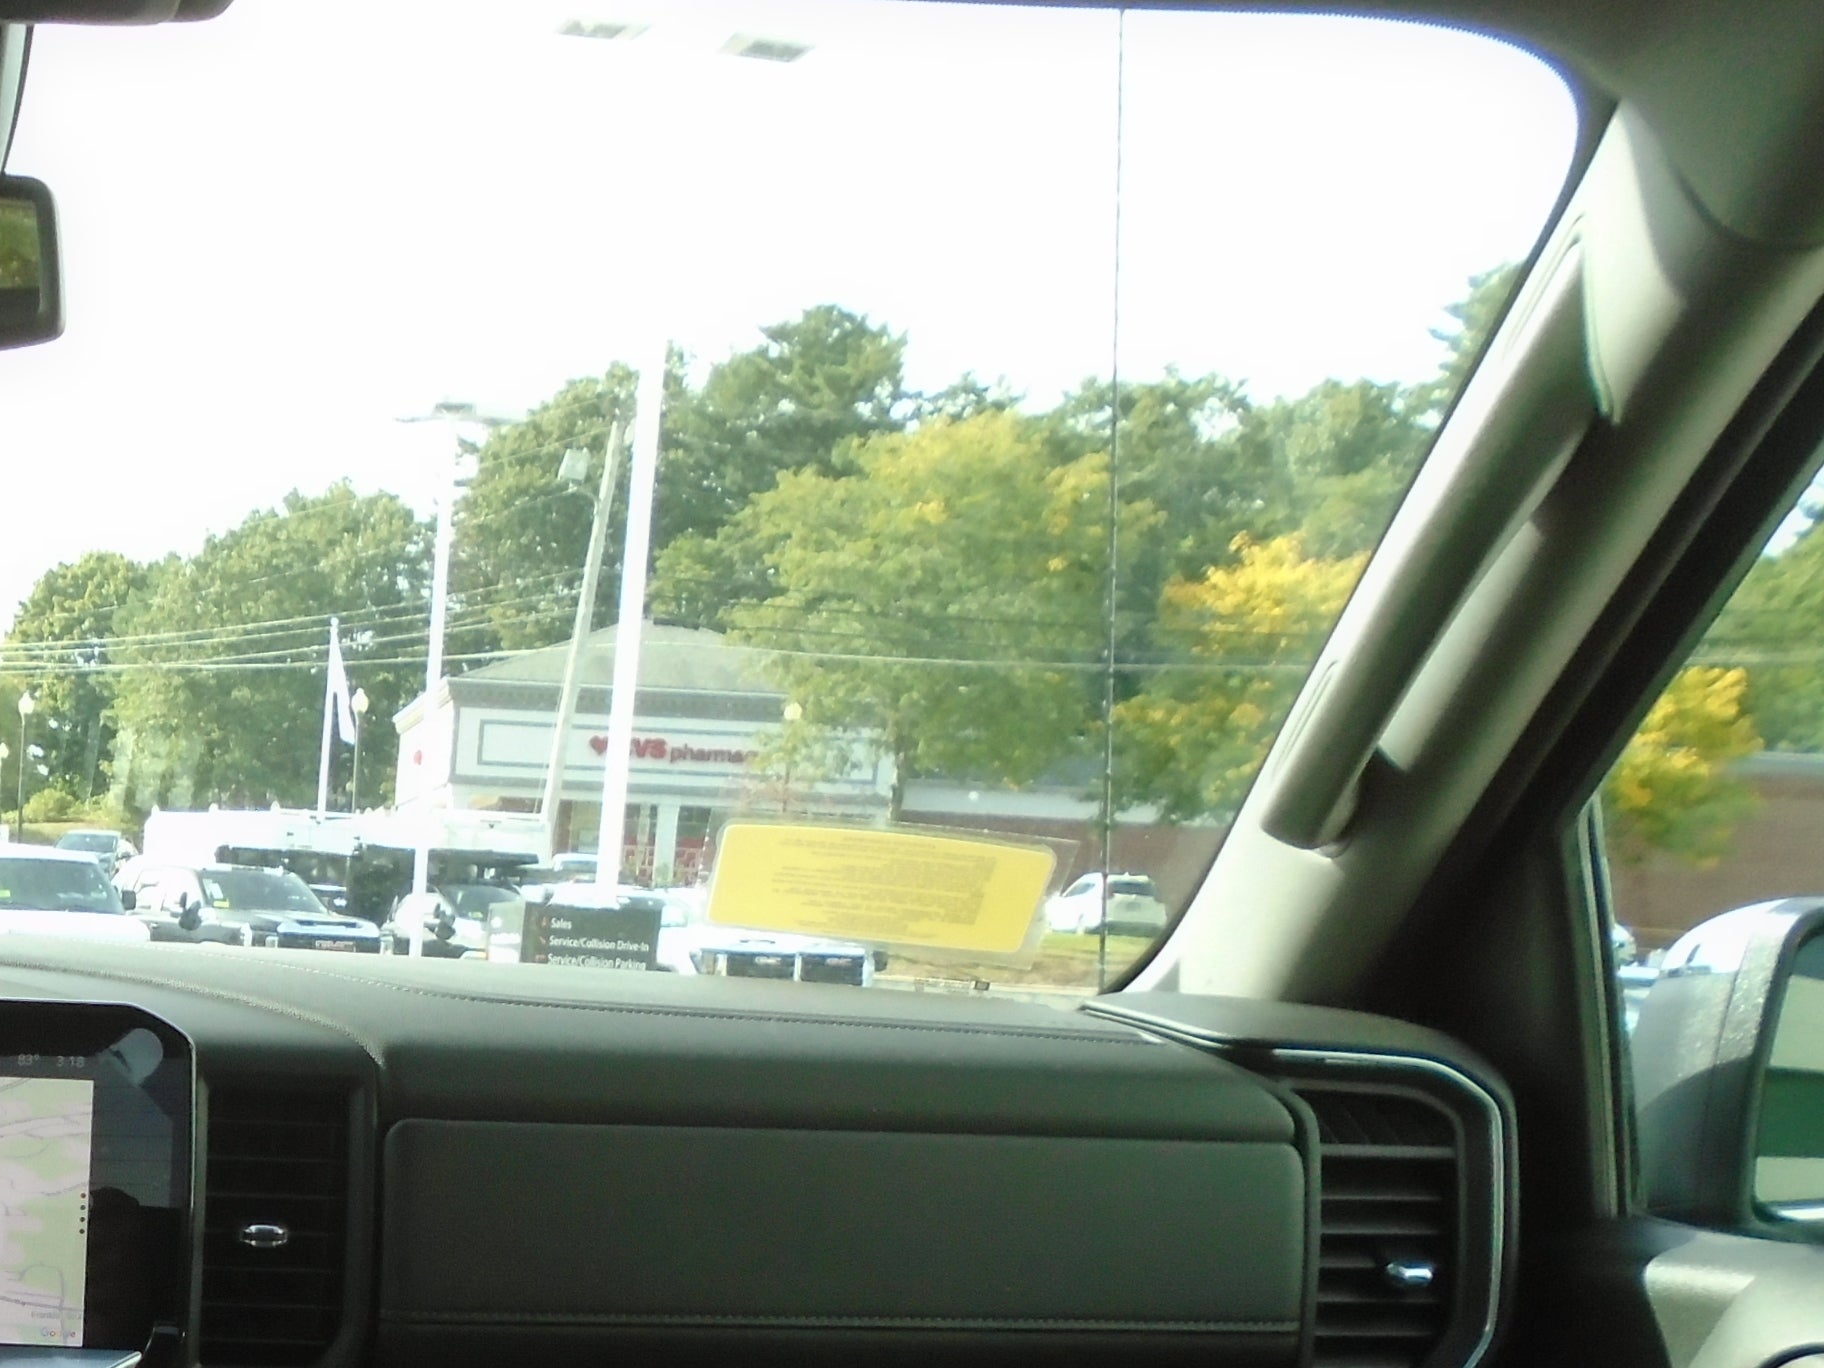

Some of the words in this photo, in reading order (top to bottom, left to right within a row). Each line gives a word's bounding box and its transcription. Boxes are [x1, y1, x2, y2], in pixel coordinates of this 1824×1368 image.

[550, 917, 573, 930] Sales
[549, 935, 616, 950] Service/Collision
[547, 953, 614, 968] Service/Collision
